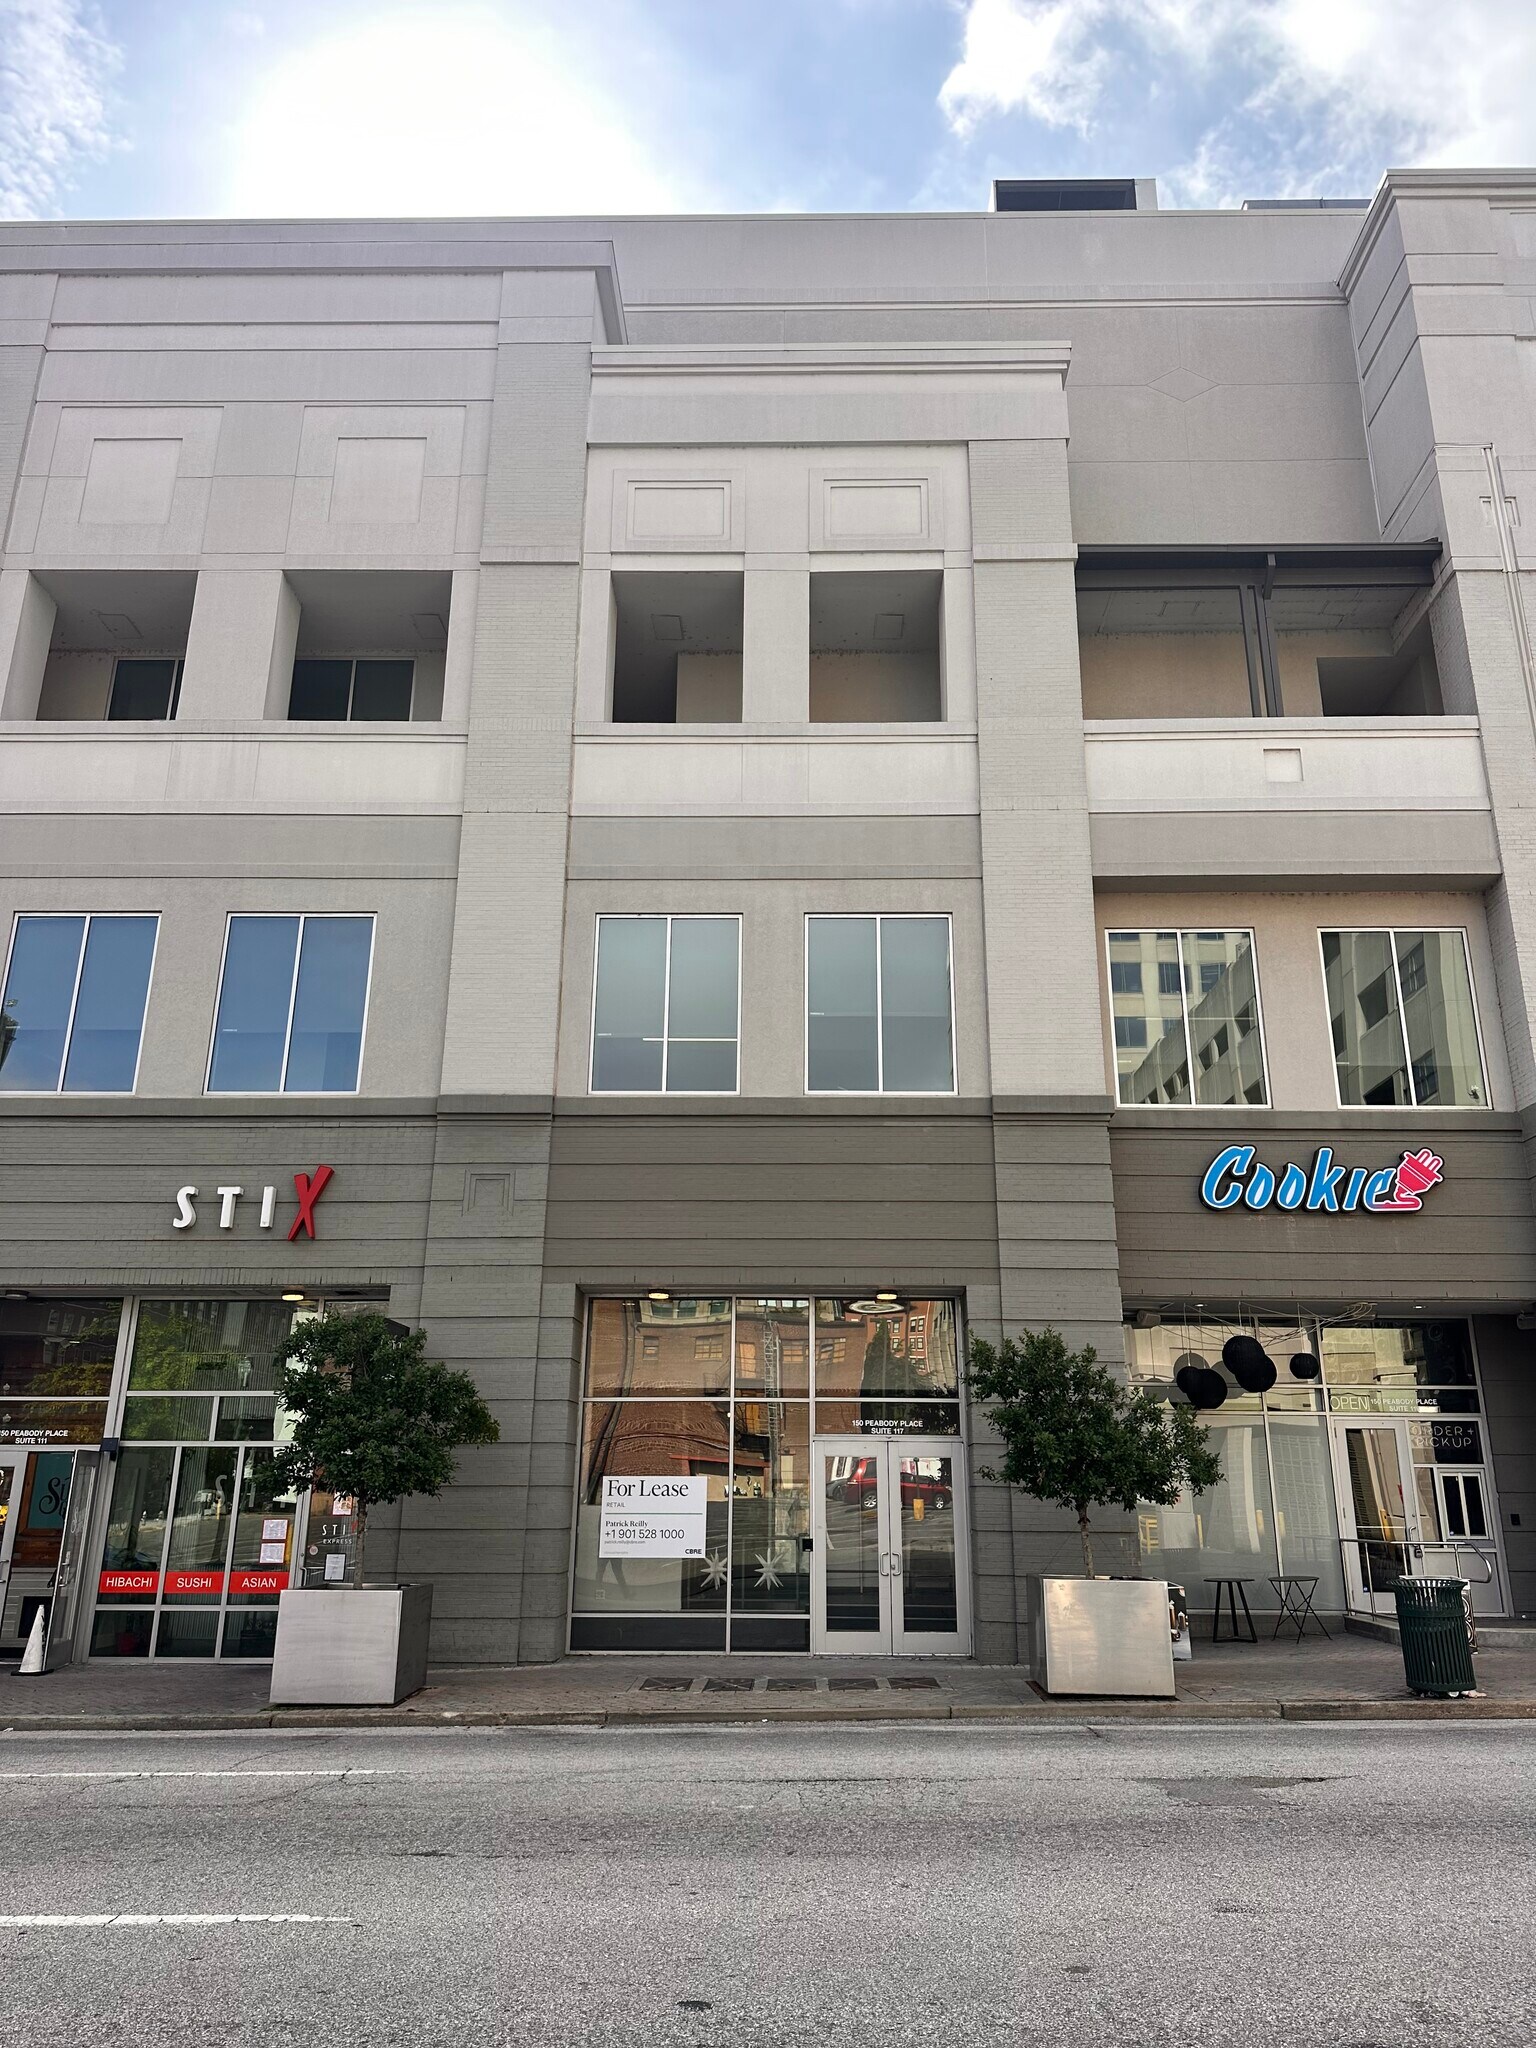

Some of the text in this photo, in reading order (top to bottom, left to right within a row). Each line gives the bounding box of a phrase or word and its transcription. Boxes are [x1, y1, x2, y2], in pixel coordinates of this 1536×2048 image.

[1200, 1145, 1397, 1212] Cookie
[172, 1164, 335, 1242] STIX
[1330, 1396, 1368, 1410] OPEN
[900, 1420, 924, 1428] PLACE
[0, 1429, 69, 1437] 50 PEABODY PLACE
[871, 1427, 892, 1435] SUITE
[1416, 1436, 1472, 1448] PICKUP
[607, 1479, 689, 1497] For Lease
[629, 1520, 648, 1529] Reilly
[604, 1529, 685, 1539] +1 901 528 1000
[105, 1577, 153, 1588] HIBACHI
[176, 1577, 212, 1588] SUSHI
[241, 1577, 277, 1588] ASIAN
